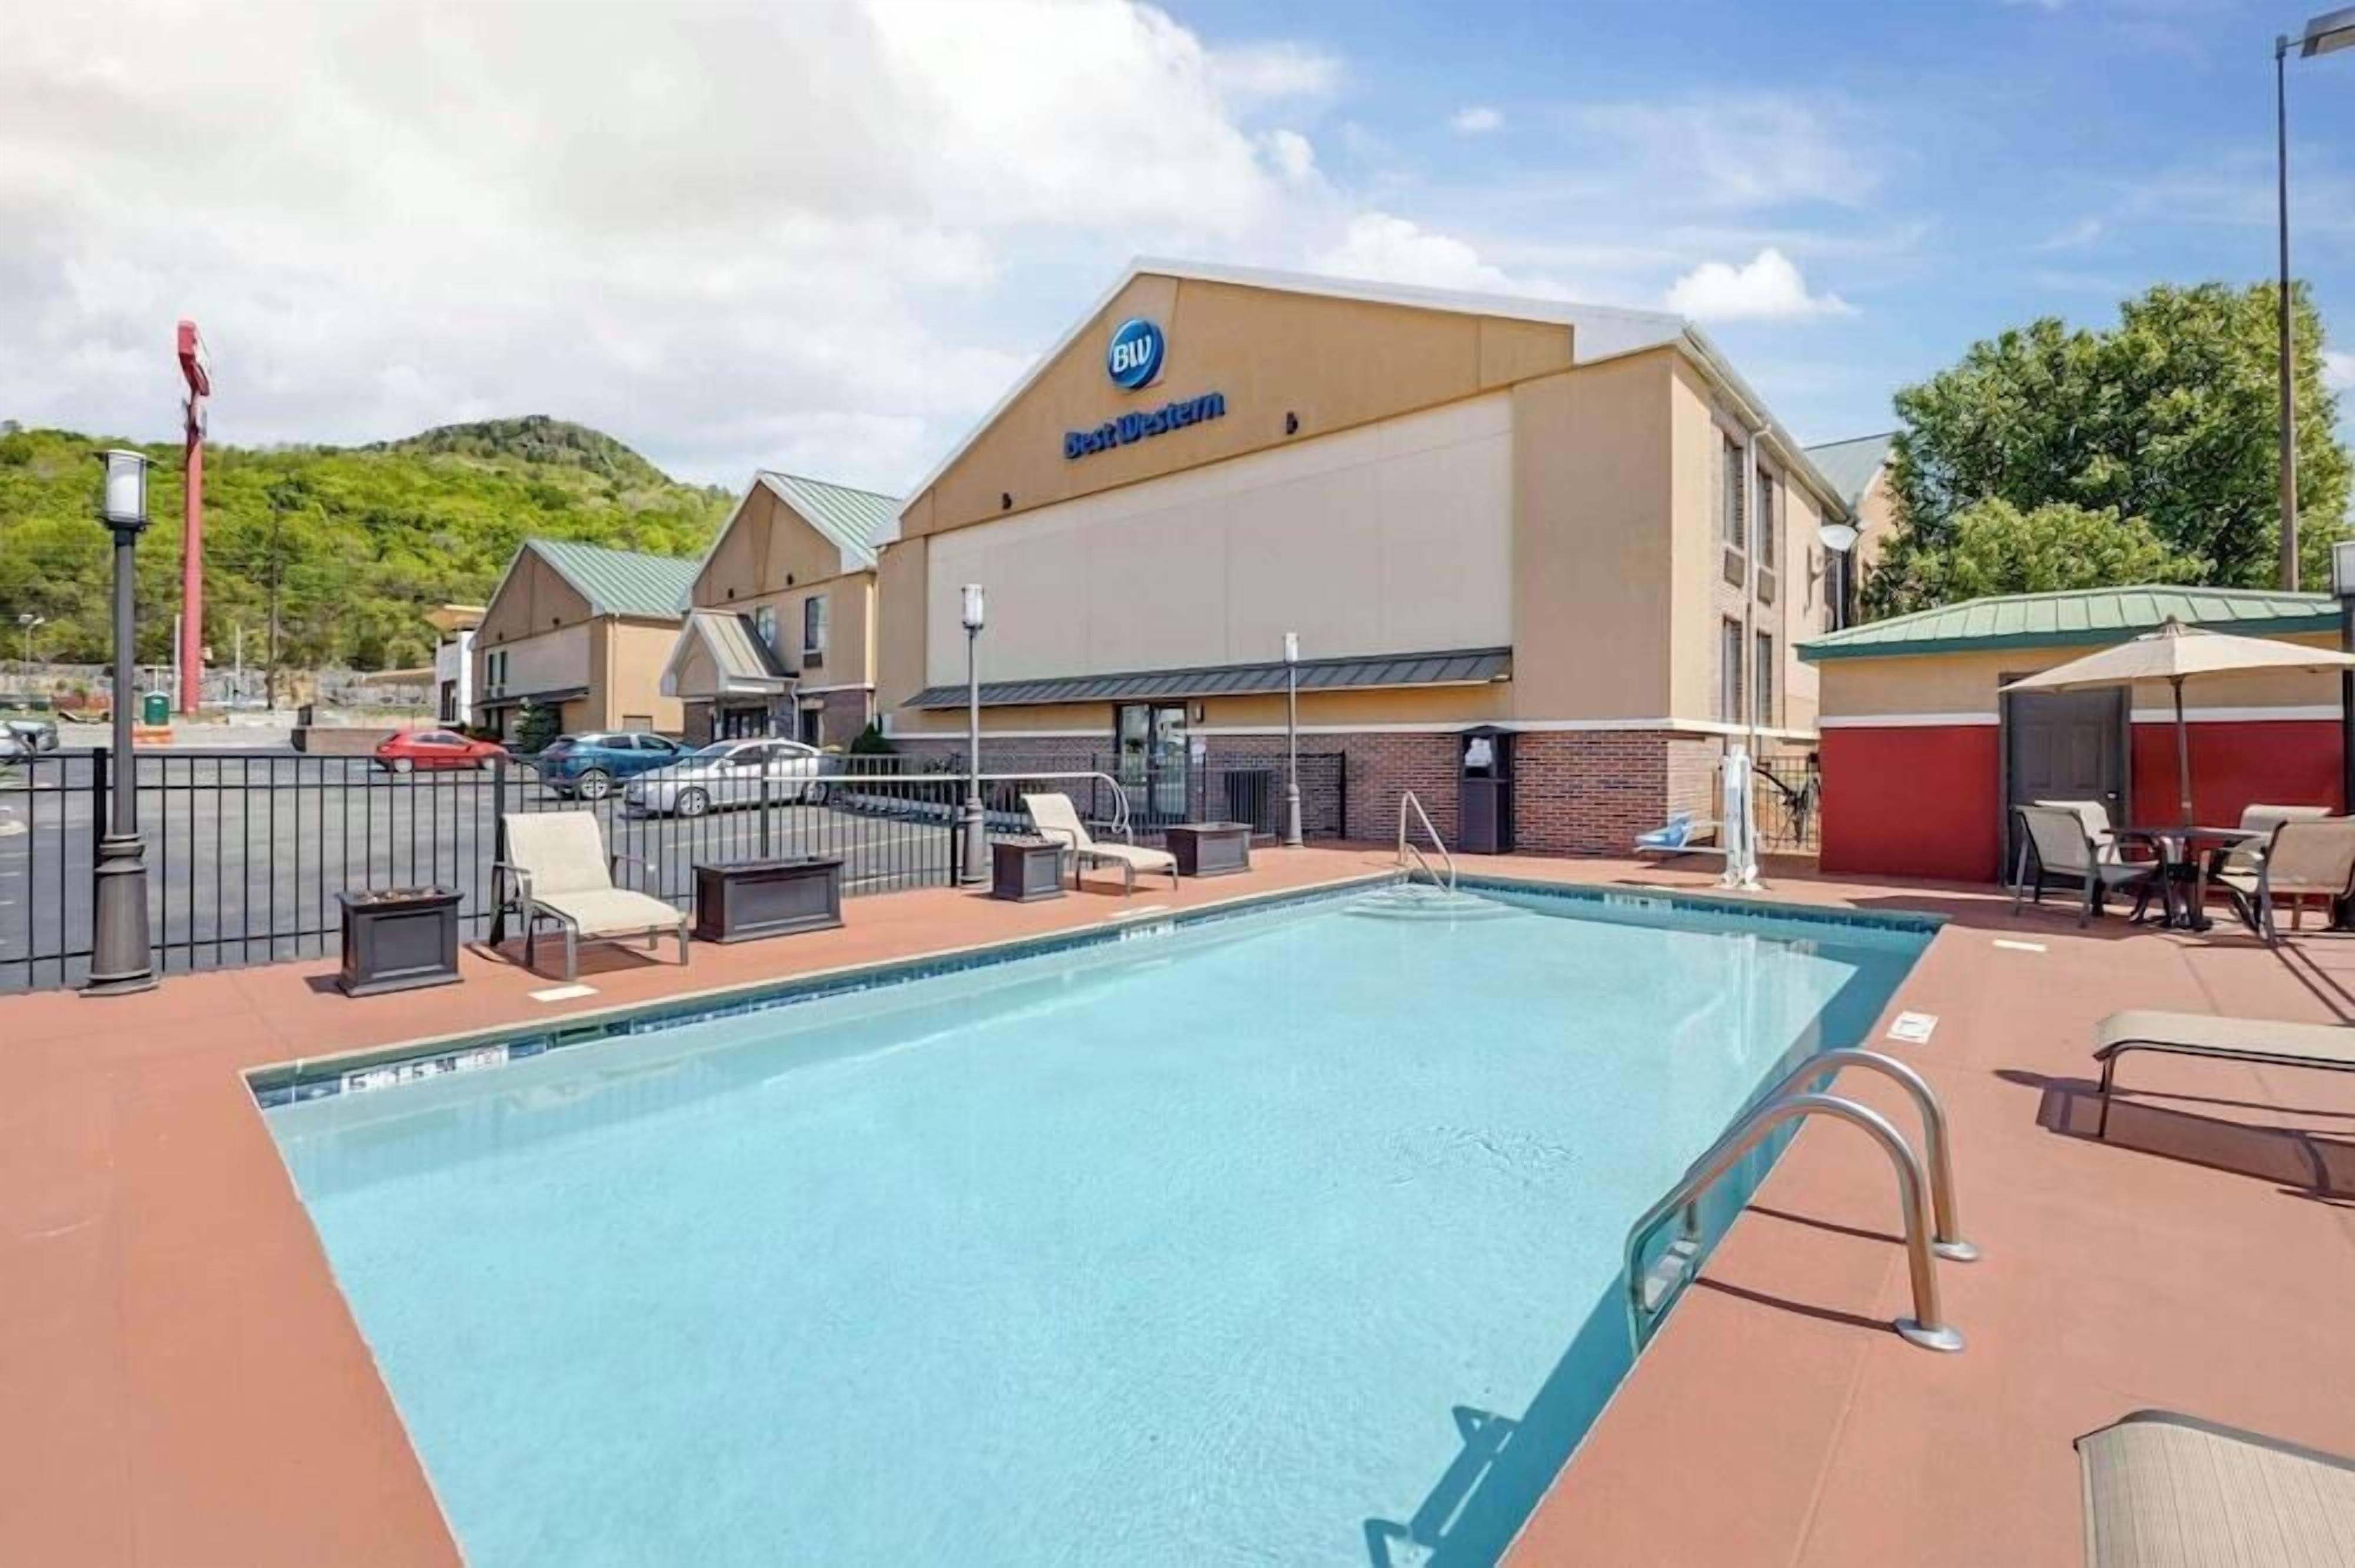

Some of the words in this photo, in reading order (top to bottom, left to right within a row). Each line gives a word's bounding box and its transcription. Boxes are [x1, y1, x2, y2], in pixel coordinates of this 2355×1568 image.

[1112, 335, 1152, 373] BW
[1064, 424, 1117, 459] Best
[1117, 393, 1225, 444] Western
